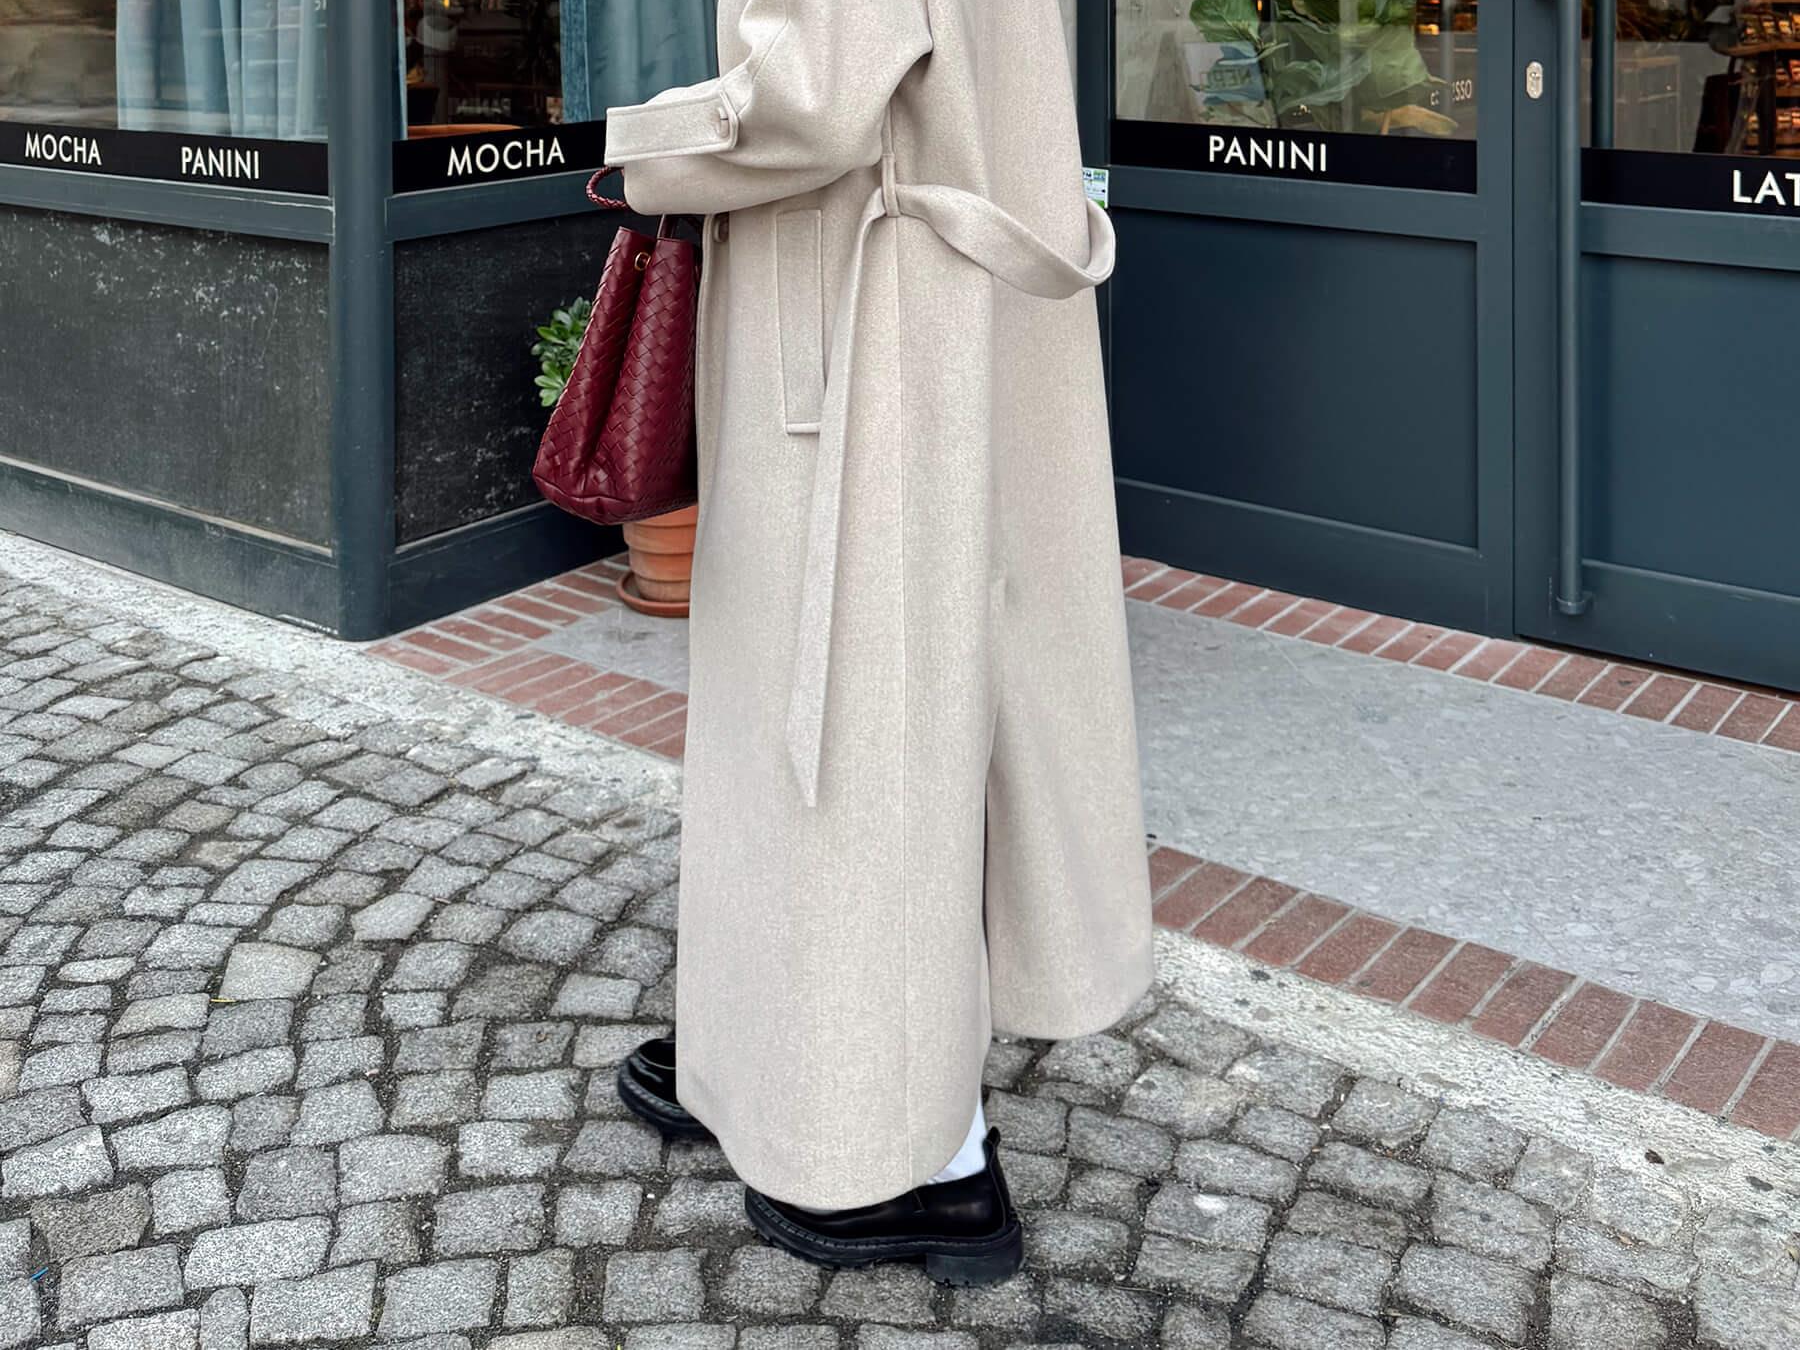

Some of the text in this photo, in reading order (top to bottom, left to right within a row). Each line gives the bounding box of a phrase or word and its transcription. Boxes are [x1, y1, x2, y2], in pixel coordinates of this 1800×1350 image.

[24, 131, 260, 179] MOCHA PANINI
[447, 136, 565, 177] MOCHA
[1208, 134, 1327, 172] PANINI
